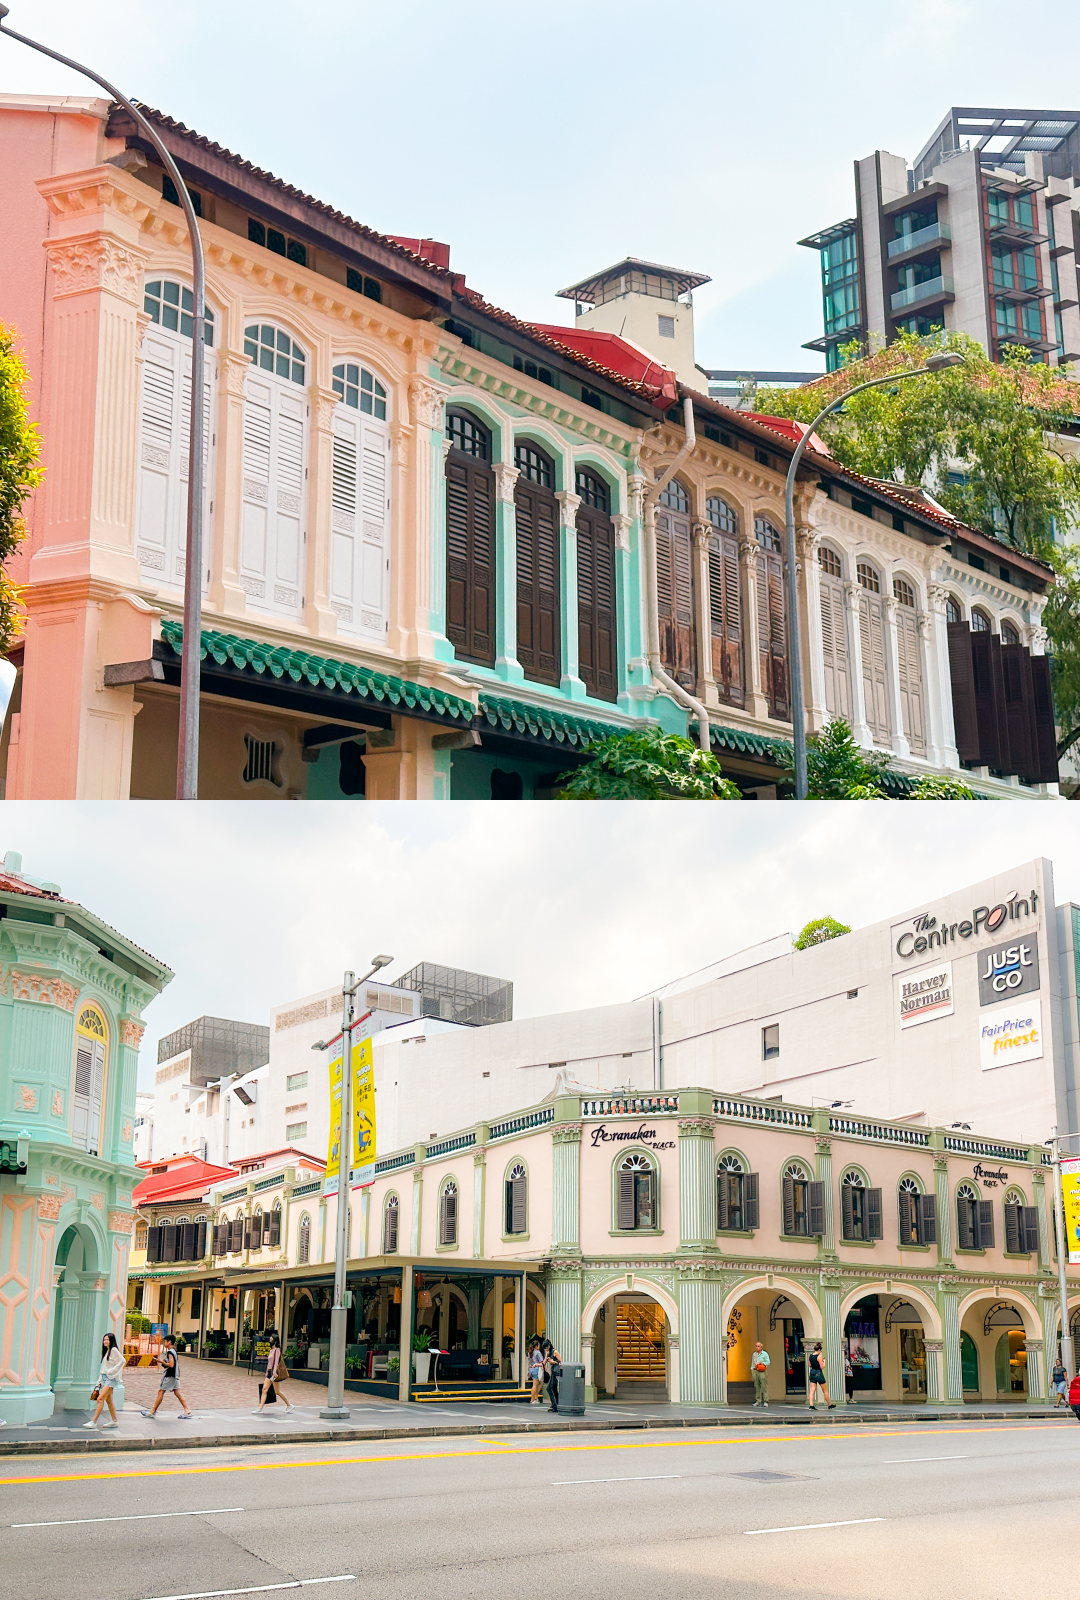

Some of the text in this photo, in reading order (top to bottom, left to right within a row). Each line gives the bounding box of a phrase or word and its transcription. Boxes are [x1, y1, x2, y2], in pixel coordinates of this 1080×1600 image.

[896, 889, 1038, 958] CentrePoint
[913, 914, 937, 932] The
[902, 973, 947, 996] Harvey
[900, 987, 950, 1012] Norman
[981, 1018, 1033, 1038] FairPrice
[993, 1028, 1039, 1054] finest
[591, 1123, 656, 1147] Peranakan
[652, 1141, 676, 1150] PLACE
